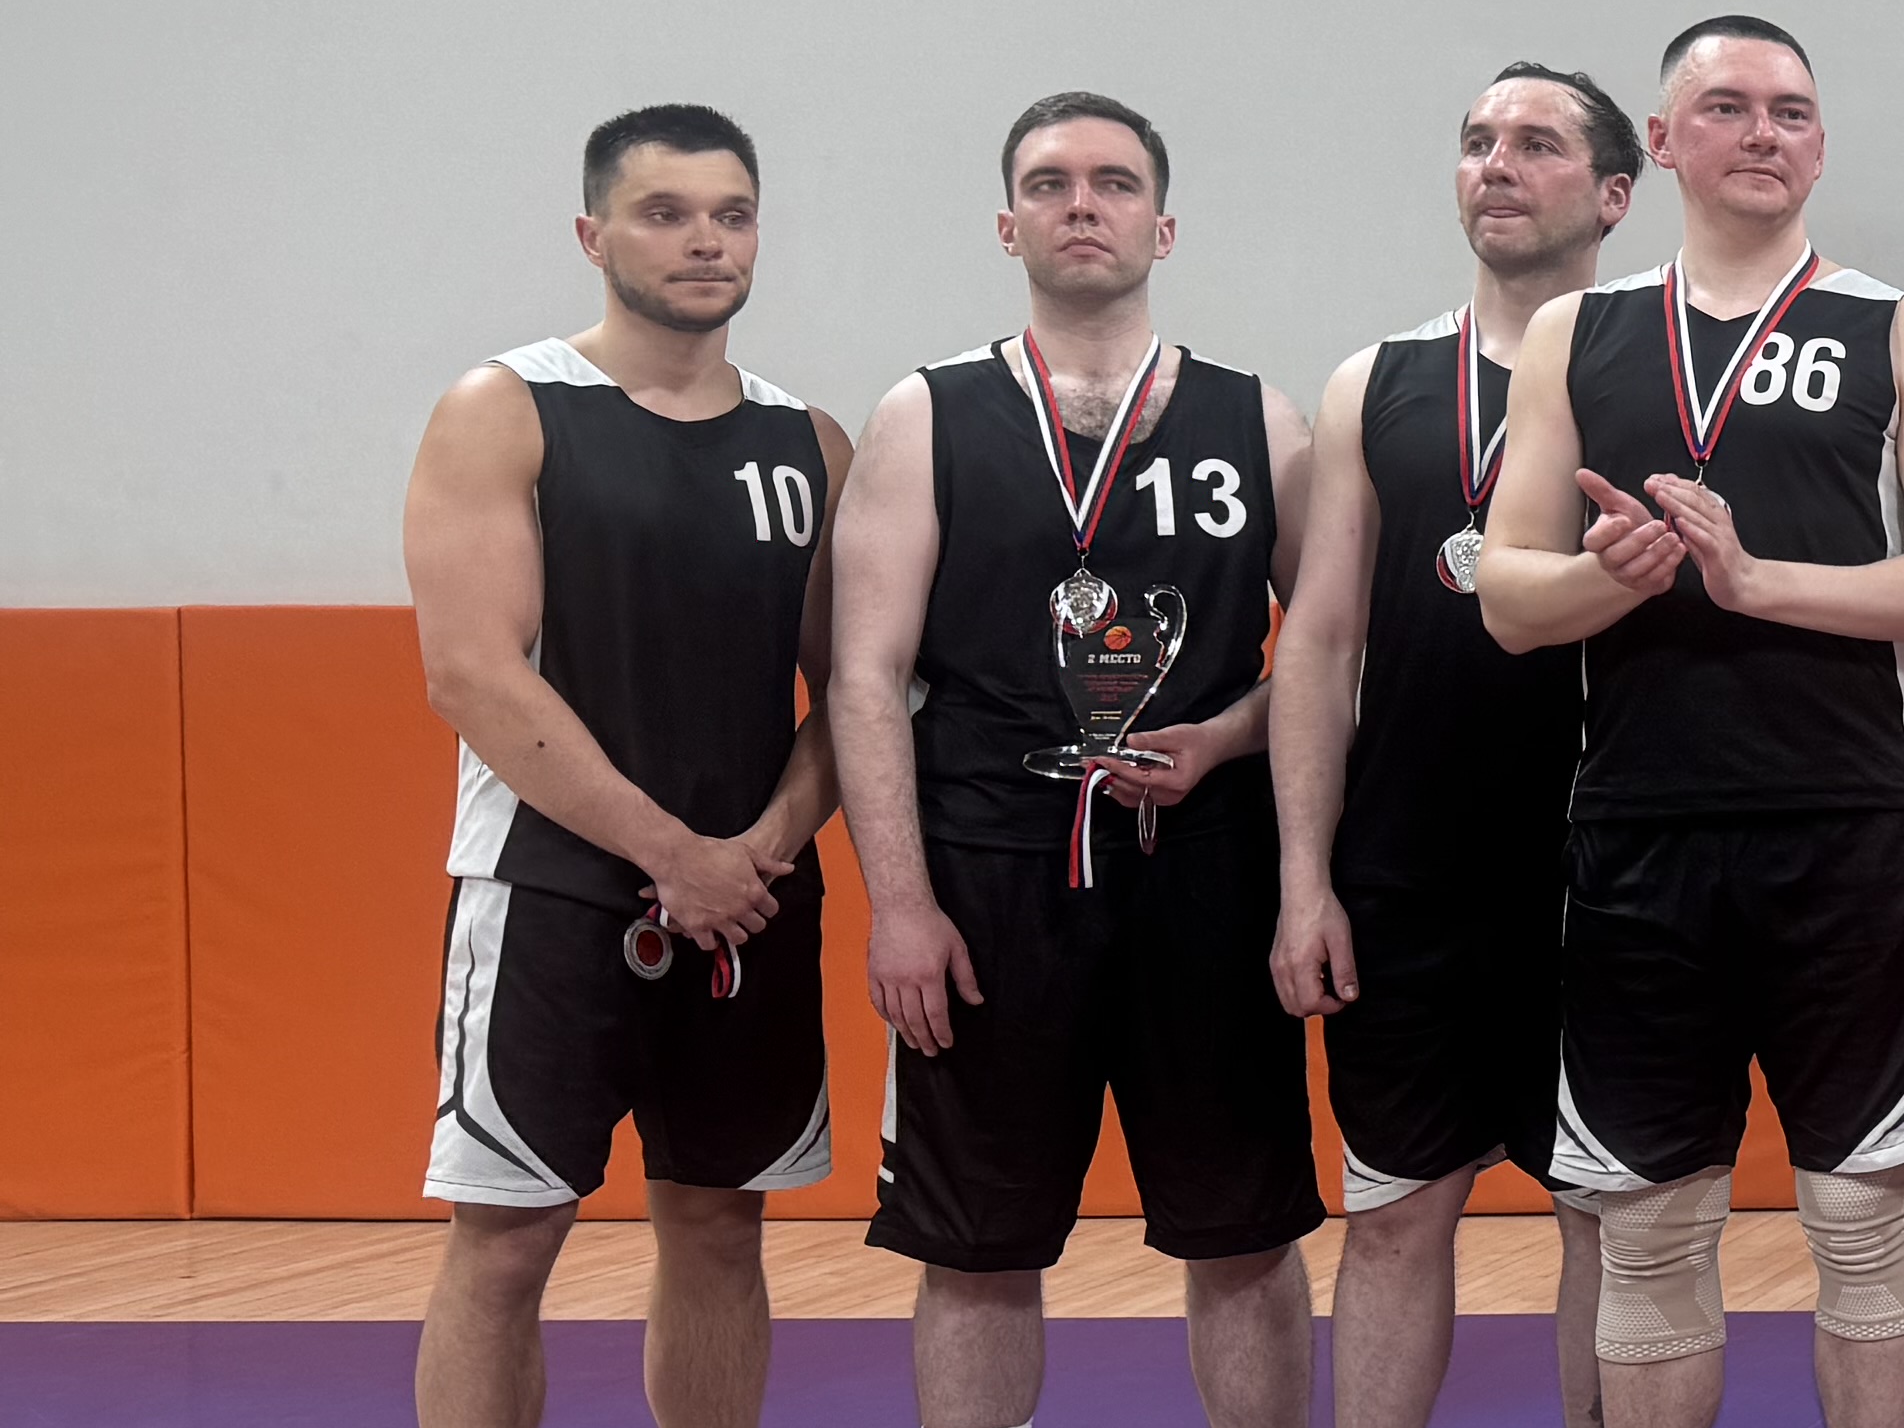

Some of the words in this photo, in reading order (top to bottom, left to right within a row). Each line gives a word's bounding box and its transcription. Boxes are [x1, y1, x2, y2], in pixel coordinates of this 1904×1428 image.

[1739, 331, 1847, 413] 86
[733, 460, 814, 548] 10
[1135, 456, 1248, 539] 13
[1099, 653, 1142, 665] МЕСТО
